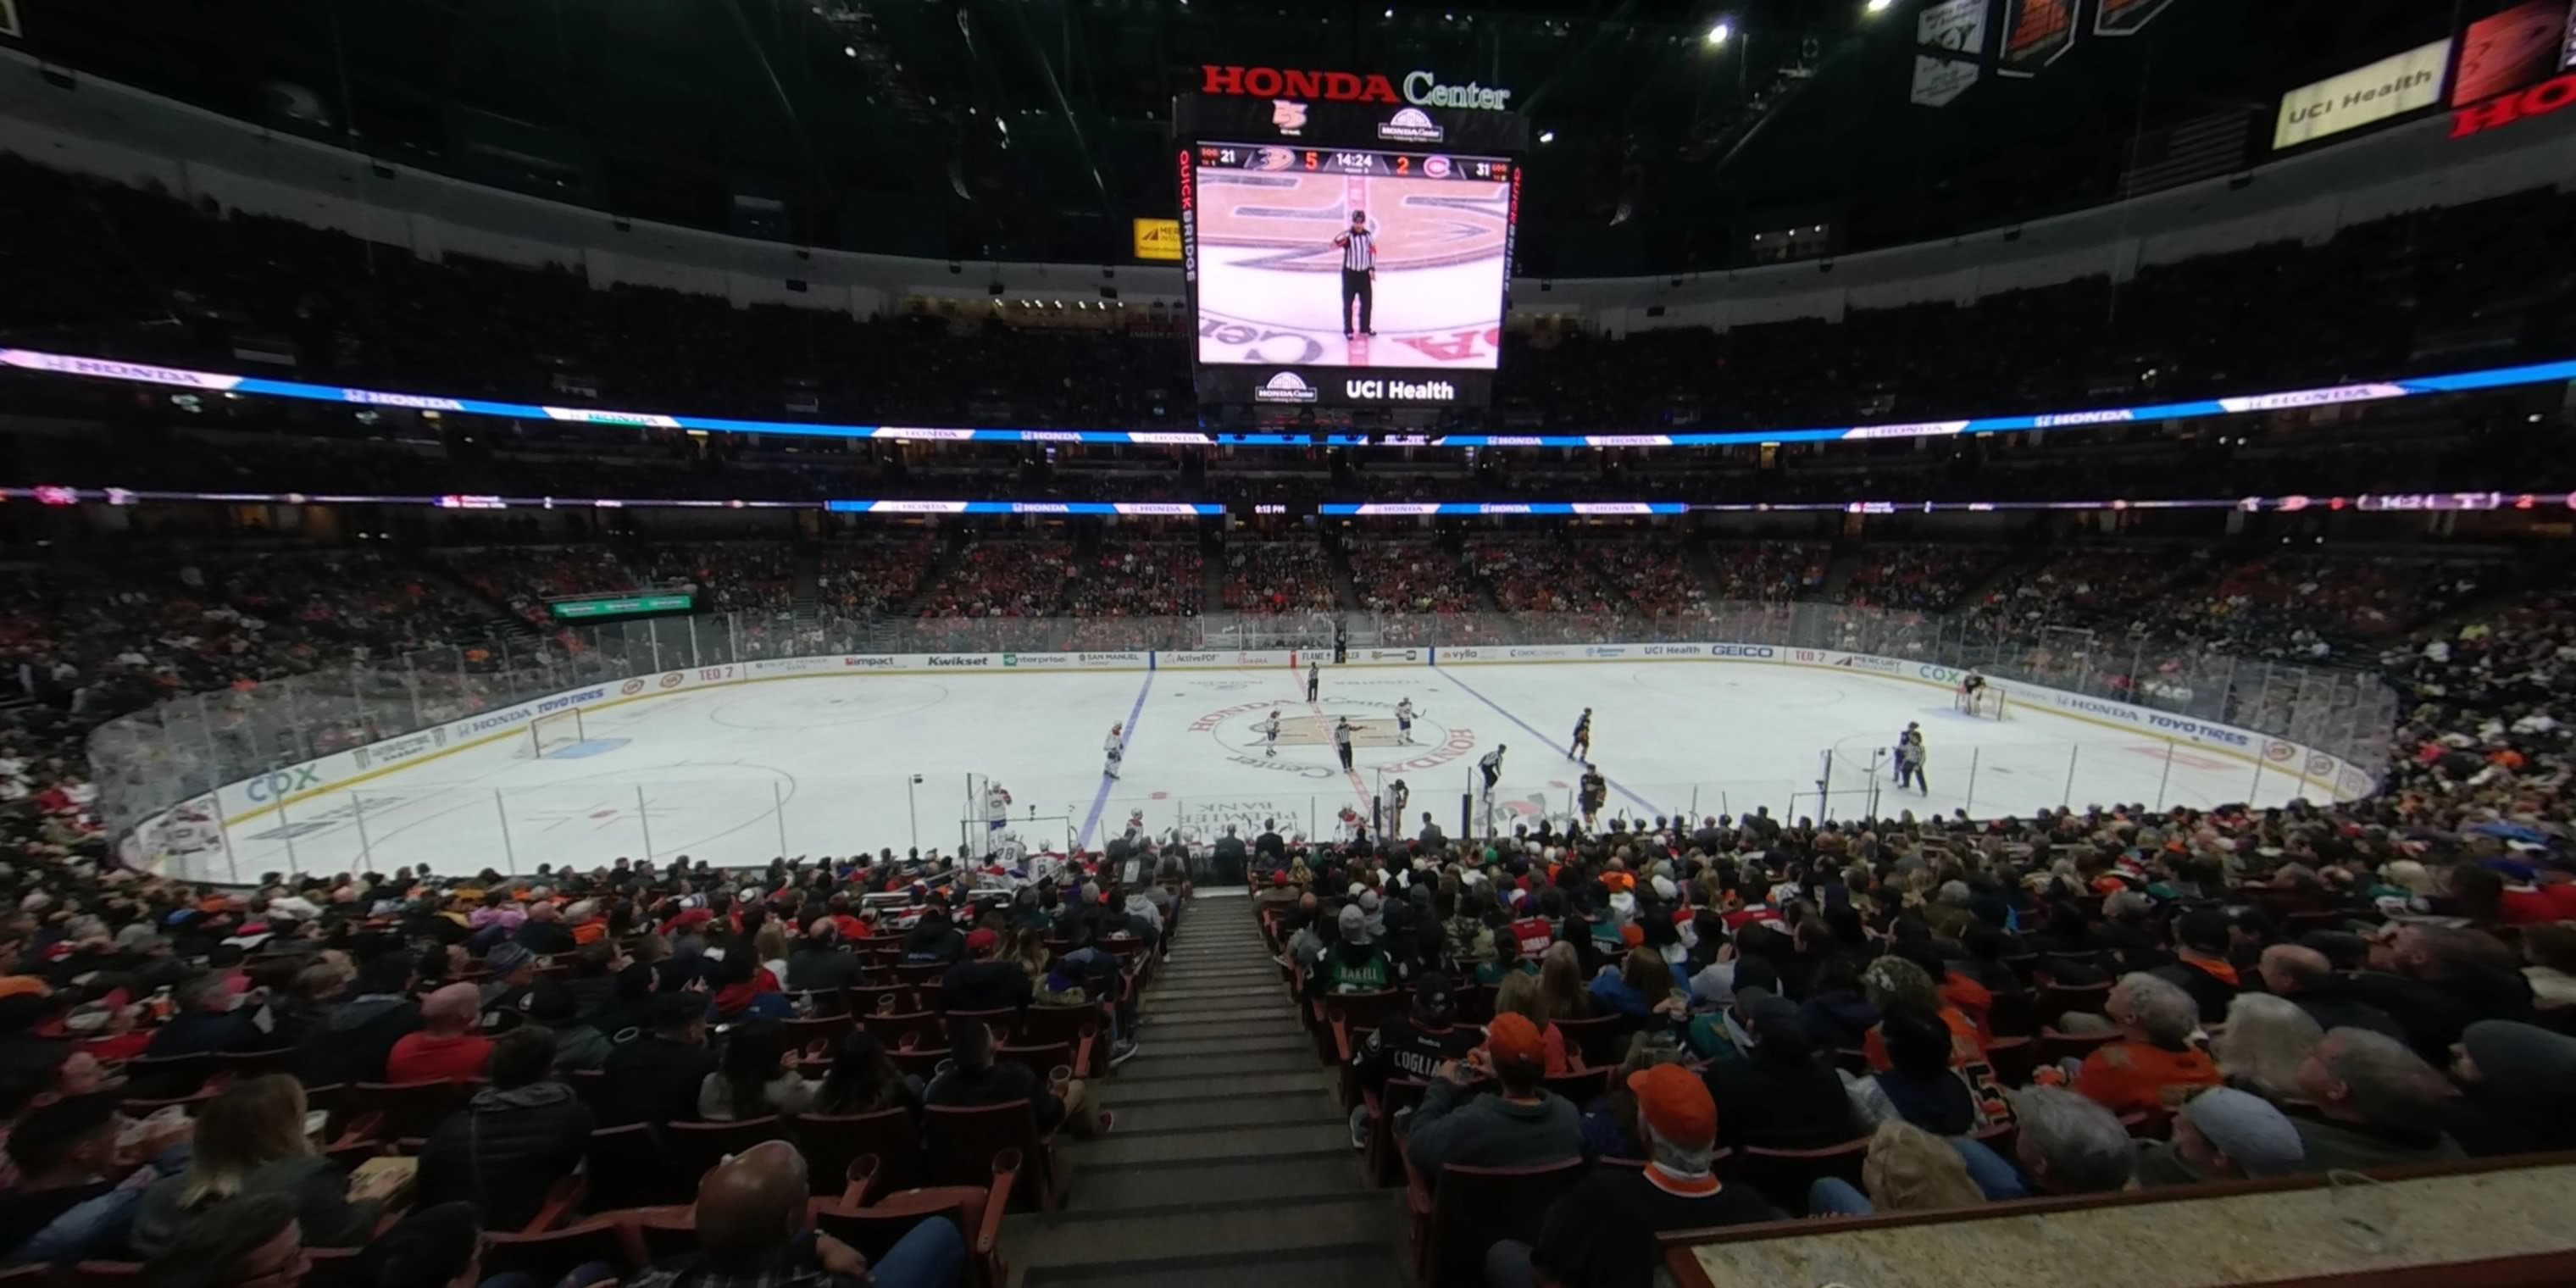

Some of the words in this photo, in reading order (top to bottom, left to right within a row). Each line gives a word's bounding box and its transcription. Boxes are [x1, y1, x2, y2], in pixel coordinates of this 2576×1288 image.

[1202, 64, 1401, 103] HONDA
[1403, 70, 1511, 110] Center
[2289, 101, 2334, 125] UCI
[2342, 69, 2434, 108] Health
[1220, 149, 1235, 164] 21
[1305, 152, 1319, 171] 5
[1336, 153, 1373, 168] 14:24
[1396, 156, 1410, 175] 2
[1476, 163, 1490, 177] 31
[75, 360, 203, 384] HONDA
[1346, 380, 1384, 399] UCI
[1389, 380, 1454, 401] Health
[2269, 386, 2373, 406] HONDA
[369, 392, 461, 410] HONDA
[2053, 409, 2135, 425] HONDA
[904, 430, 958, 439] HONDA
[1032, 431, 1082, 441] HONDA
[1152, 433, 1201, 442] HONDA
[1498, 436, 1542, 446] HONDA
[901, 502, 949, 511] HONDA
[1023, 503, 1069, 514] HONDA
[1138, 504, 1182, 514] HONDA
[1272, 504, 1286, 514] PM
[1490, 504, 1531, 514] HONDA
[1302, 652, 1325, 661] FLAME
[1452, 649, 1478, 660] vylla
[1645, 647, 1663, 655] UCI
[1666, 646, 1701, 655] Health
[1712, 645, 1774, 658] GEICO
[853, 656, 895, 667] impact
[928, 656, 988, 667] Kwikset
[1105, 653, 1140, 662] MANUEL
[1176, 654, 1217, 663] ActivePDF
[1919, 664, 1961, 685] COX
[471, 708, 532, 733] HONDA
[537, 696, 569, 714] TOYO
[569, 688, 606, 705] TIRES
[1188, 698, 1293, 733] HONDA
[2070, 697, 2140, 721] HONDA
[2148, 713, 2196, 733] TOYO
[2198, 725, 2250, 747] TIRES
[1383, 728, 1476, 774] HONDA
[1226, 755, 1335, 779] Center
[247, 763, 319, 802] COX
[1198, 802, 1274, 812] BANK
[1340, 966, 1378, 980] RAKELL
